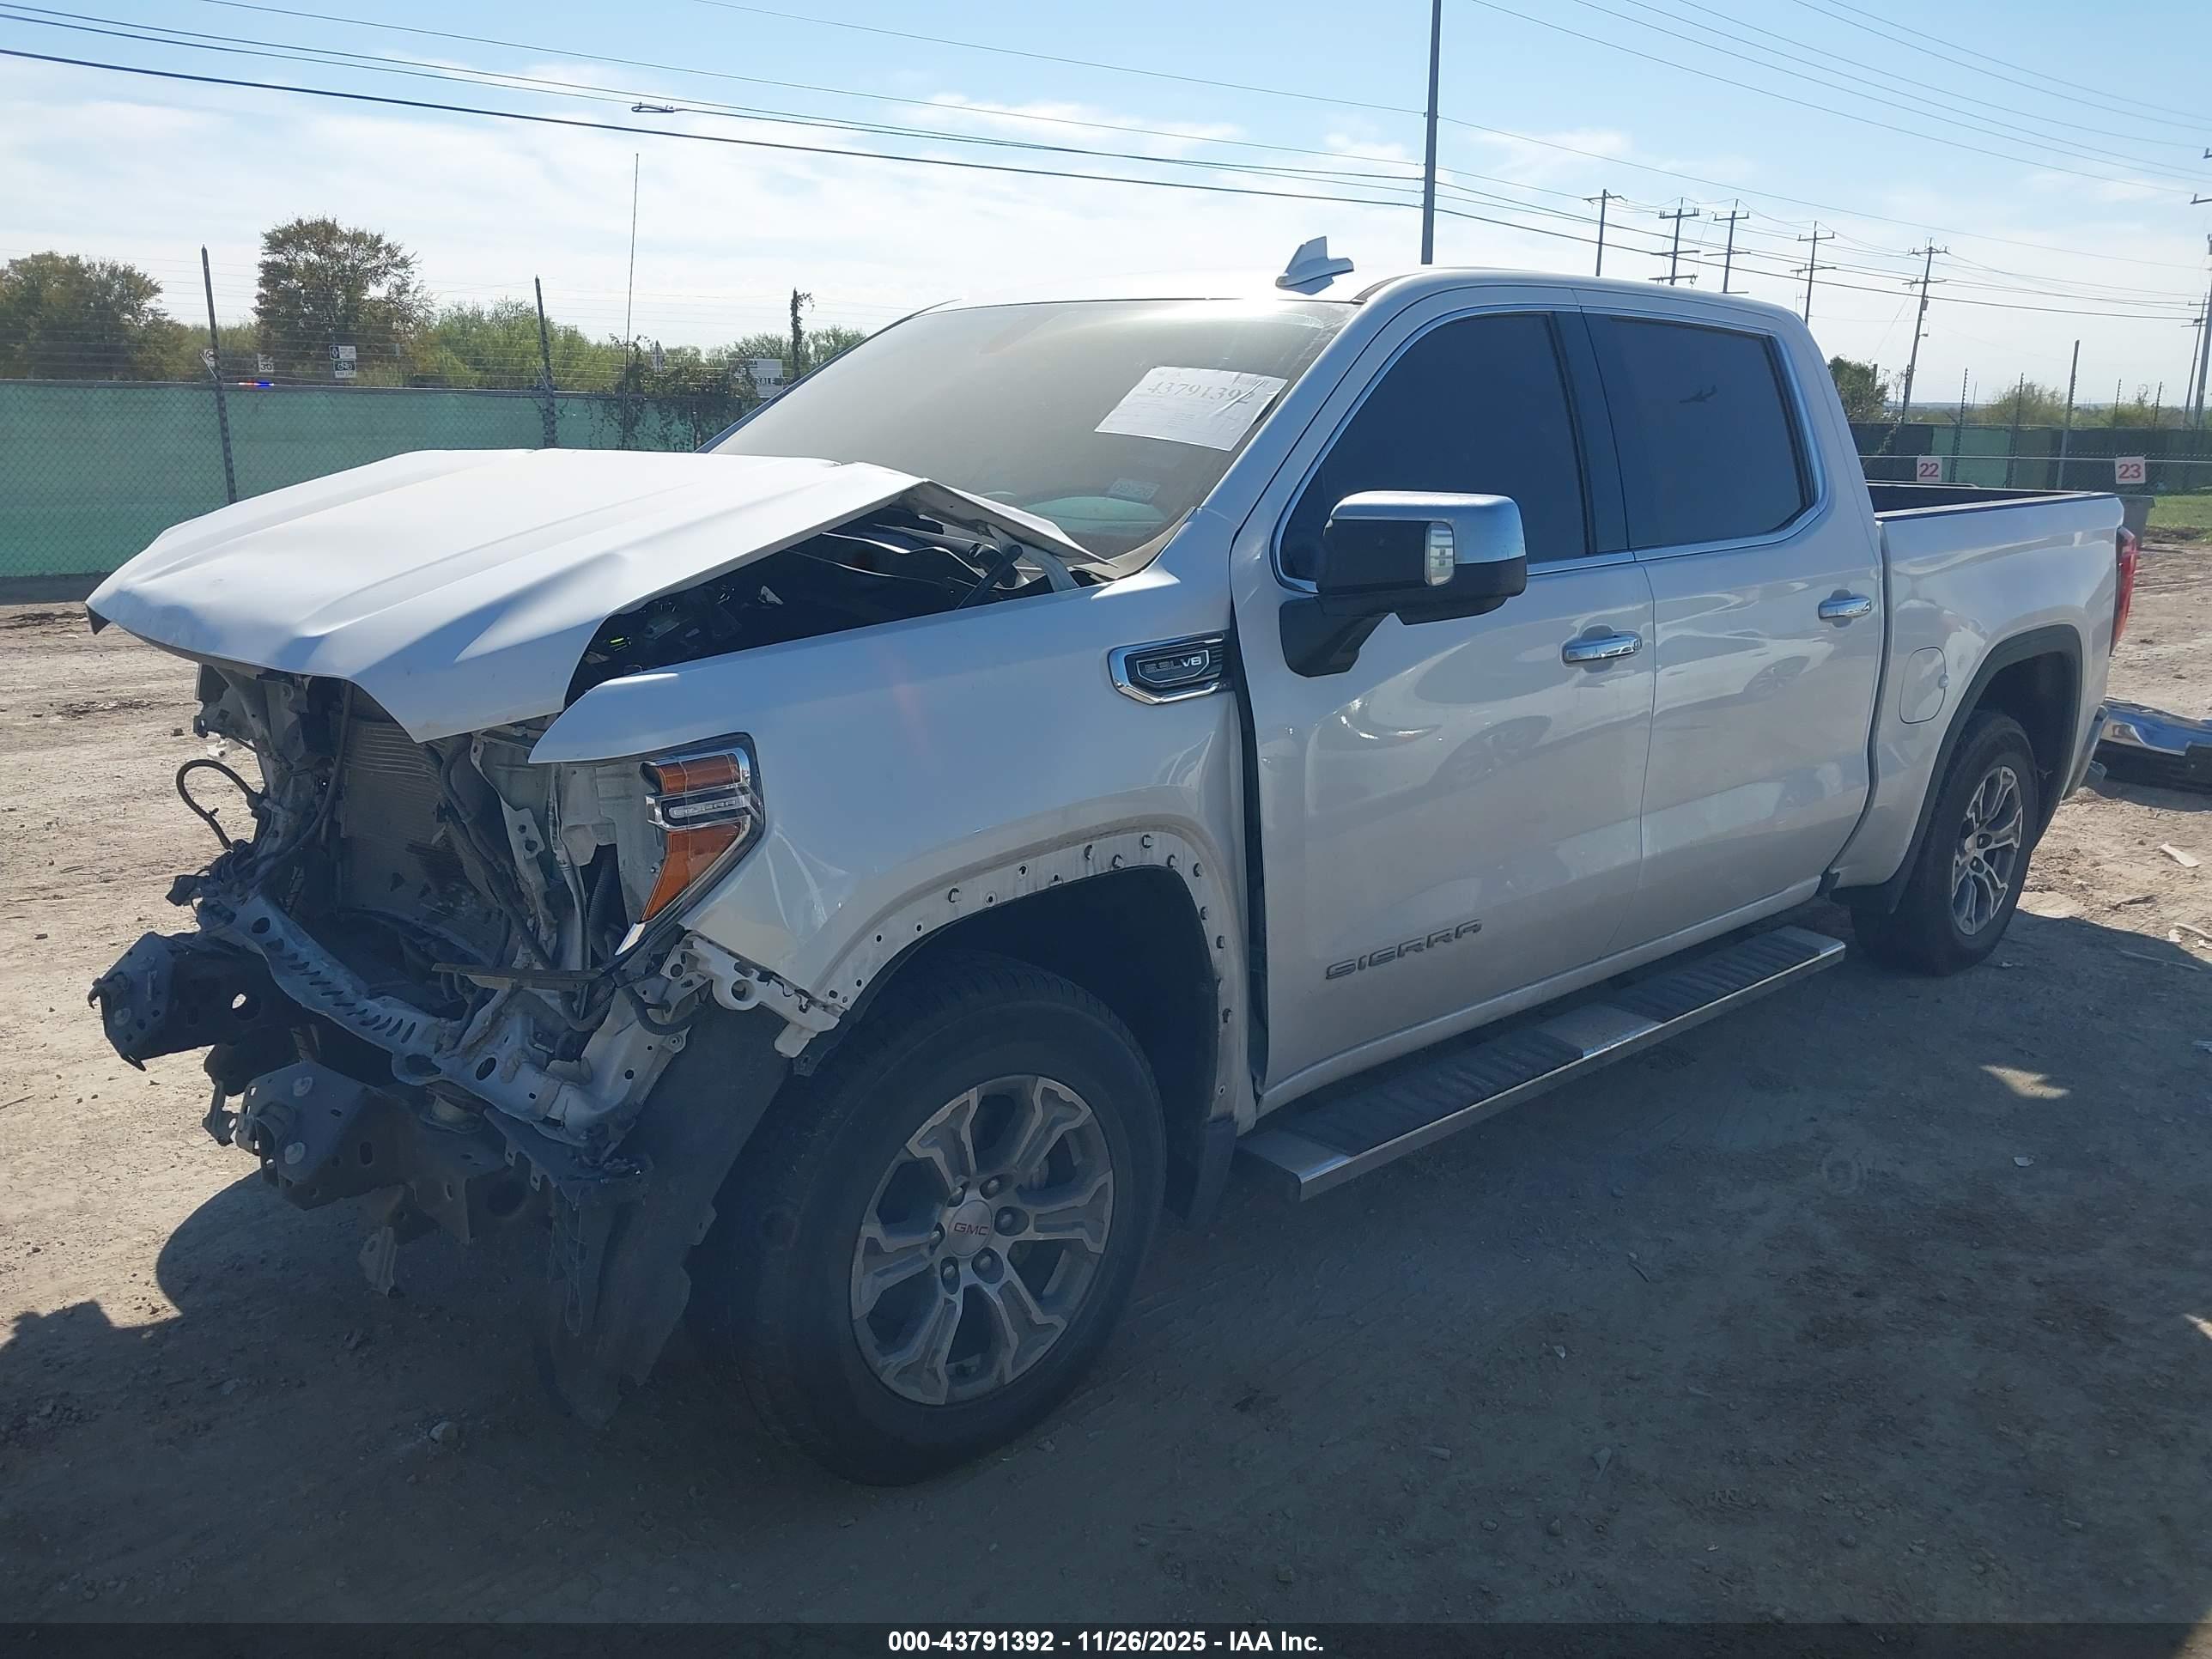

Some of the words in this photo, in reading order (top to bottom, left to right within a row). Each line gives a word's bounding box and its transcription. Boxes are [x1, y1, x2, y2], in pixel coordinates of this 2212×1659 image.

[260, 362, 273, 371] 30
[1146, 380, 1255, 404] 43791392
[1918, 462, 1940, 477] 22
[2118, 463, 2142, 479] 23
[1325, 918, 1483, 981] SIERRA
[953, 1222, 990, 1237] GMC
